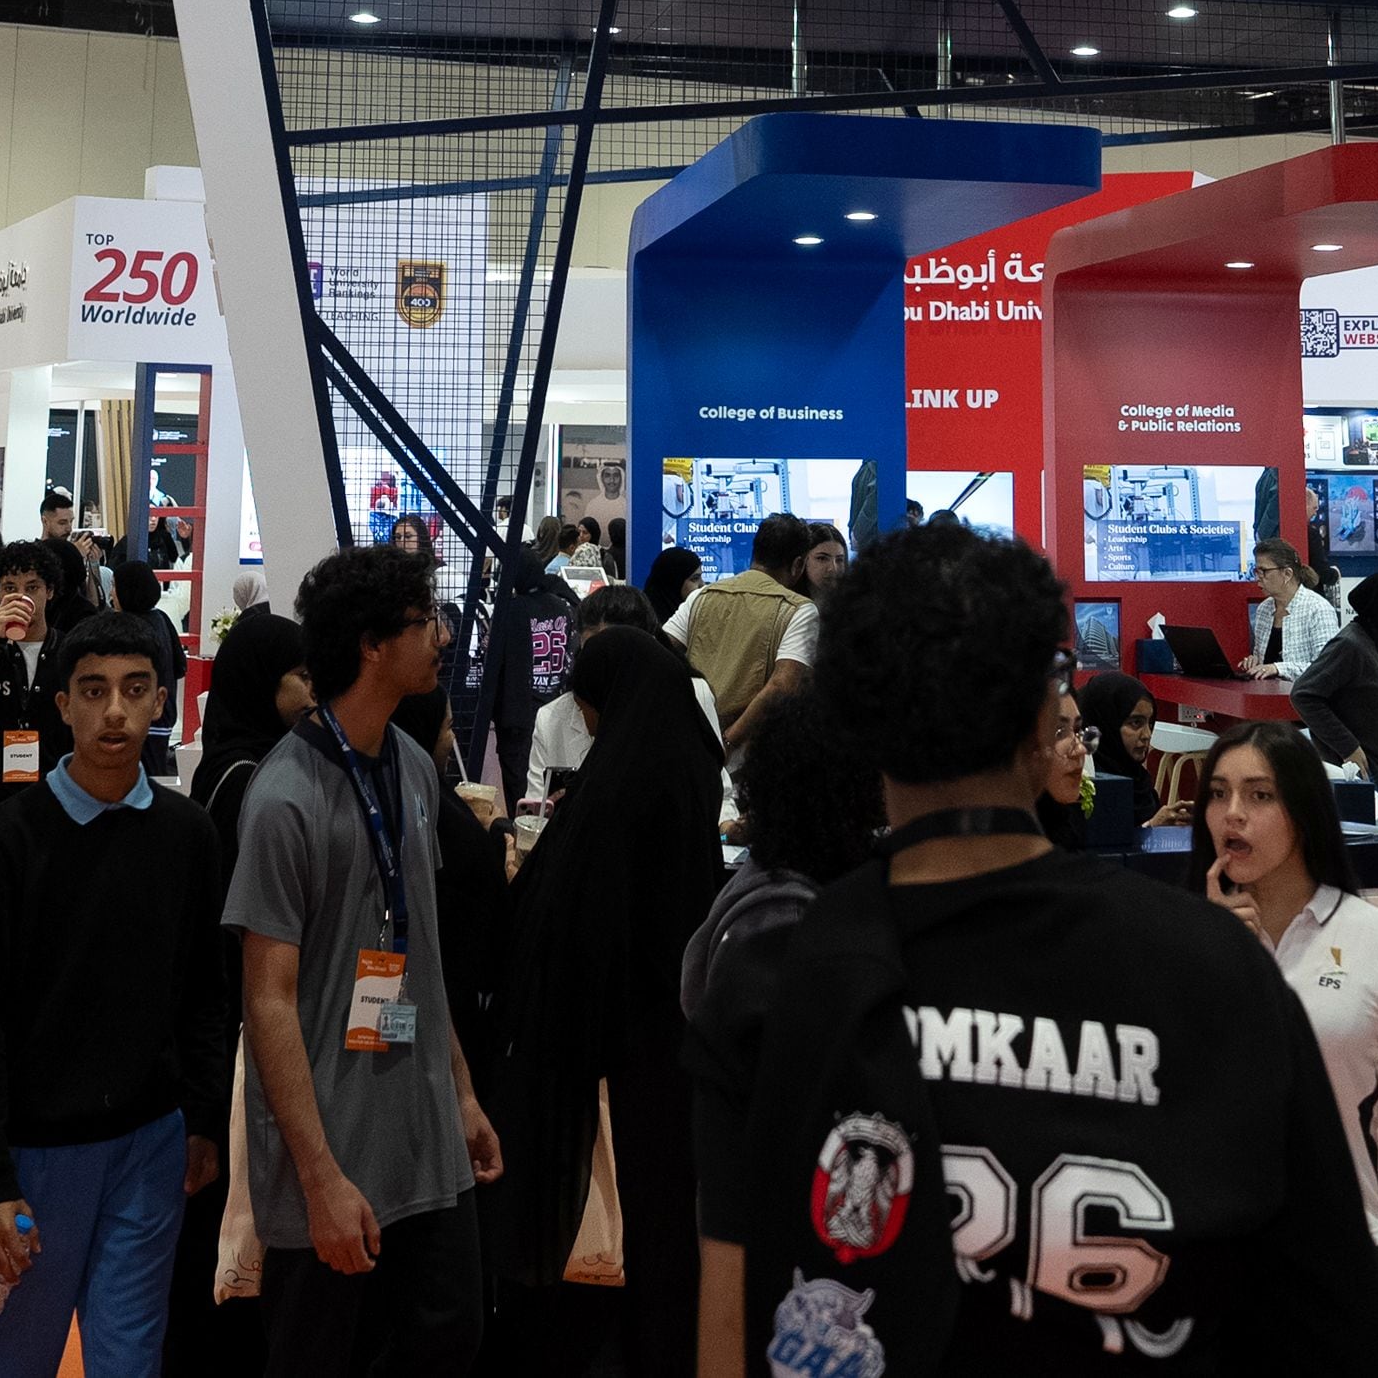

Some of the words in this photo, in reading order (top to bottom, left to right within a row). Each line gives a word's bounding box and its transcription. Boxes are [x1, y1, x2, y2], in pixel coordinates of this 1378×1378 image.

[85, 233, 114, 246] TOP
[83, 248, 199, 306] 250
[904, 249, 996, 292] أبوظب
[81, 304, 197, 326] Worldwide
[928, 300, 990, 321] Dhabi
[995, 300, 1043, 321] Univ
[966, 389, 999, 409] UP
[699, 406, 756, 422] College
[759, 406, 775, 420] of
[777, 406, 844, 421] Business
[1120, 405, 1173, 418] College
[1175, 404, 1190, 417] of
[1192, 405, 1235, 418] Media
[1118, 421, 1129, 432] &
[1131, 420, 1174, 432] Public
[1177, 420, 1241, 433] Relations
[689, 523, 731, 534] Student
[733, 523, 760, 534] Club
[1107, 524, 1147, 535] Student
[1149, 524, 1178, 535] Clubs
[1179, 525, 1189, 535] &
[1189, 524, 1235, 535] Societies
[688, 535, 732, 545] Leadership
[1107, 535, 1148, 544] Leadership
[688, 544, 705, 553] Arts
[1107, 544, 1123, 552] Arts
[1107, 554, 1132, 562] Sports
[1107, 563, 1135, 571] Culture
[1318, 976, 1342, 990] EPS
